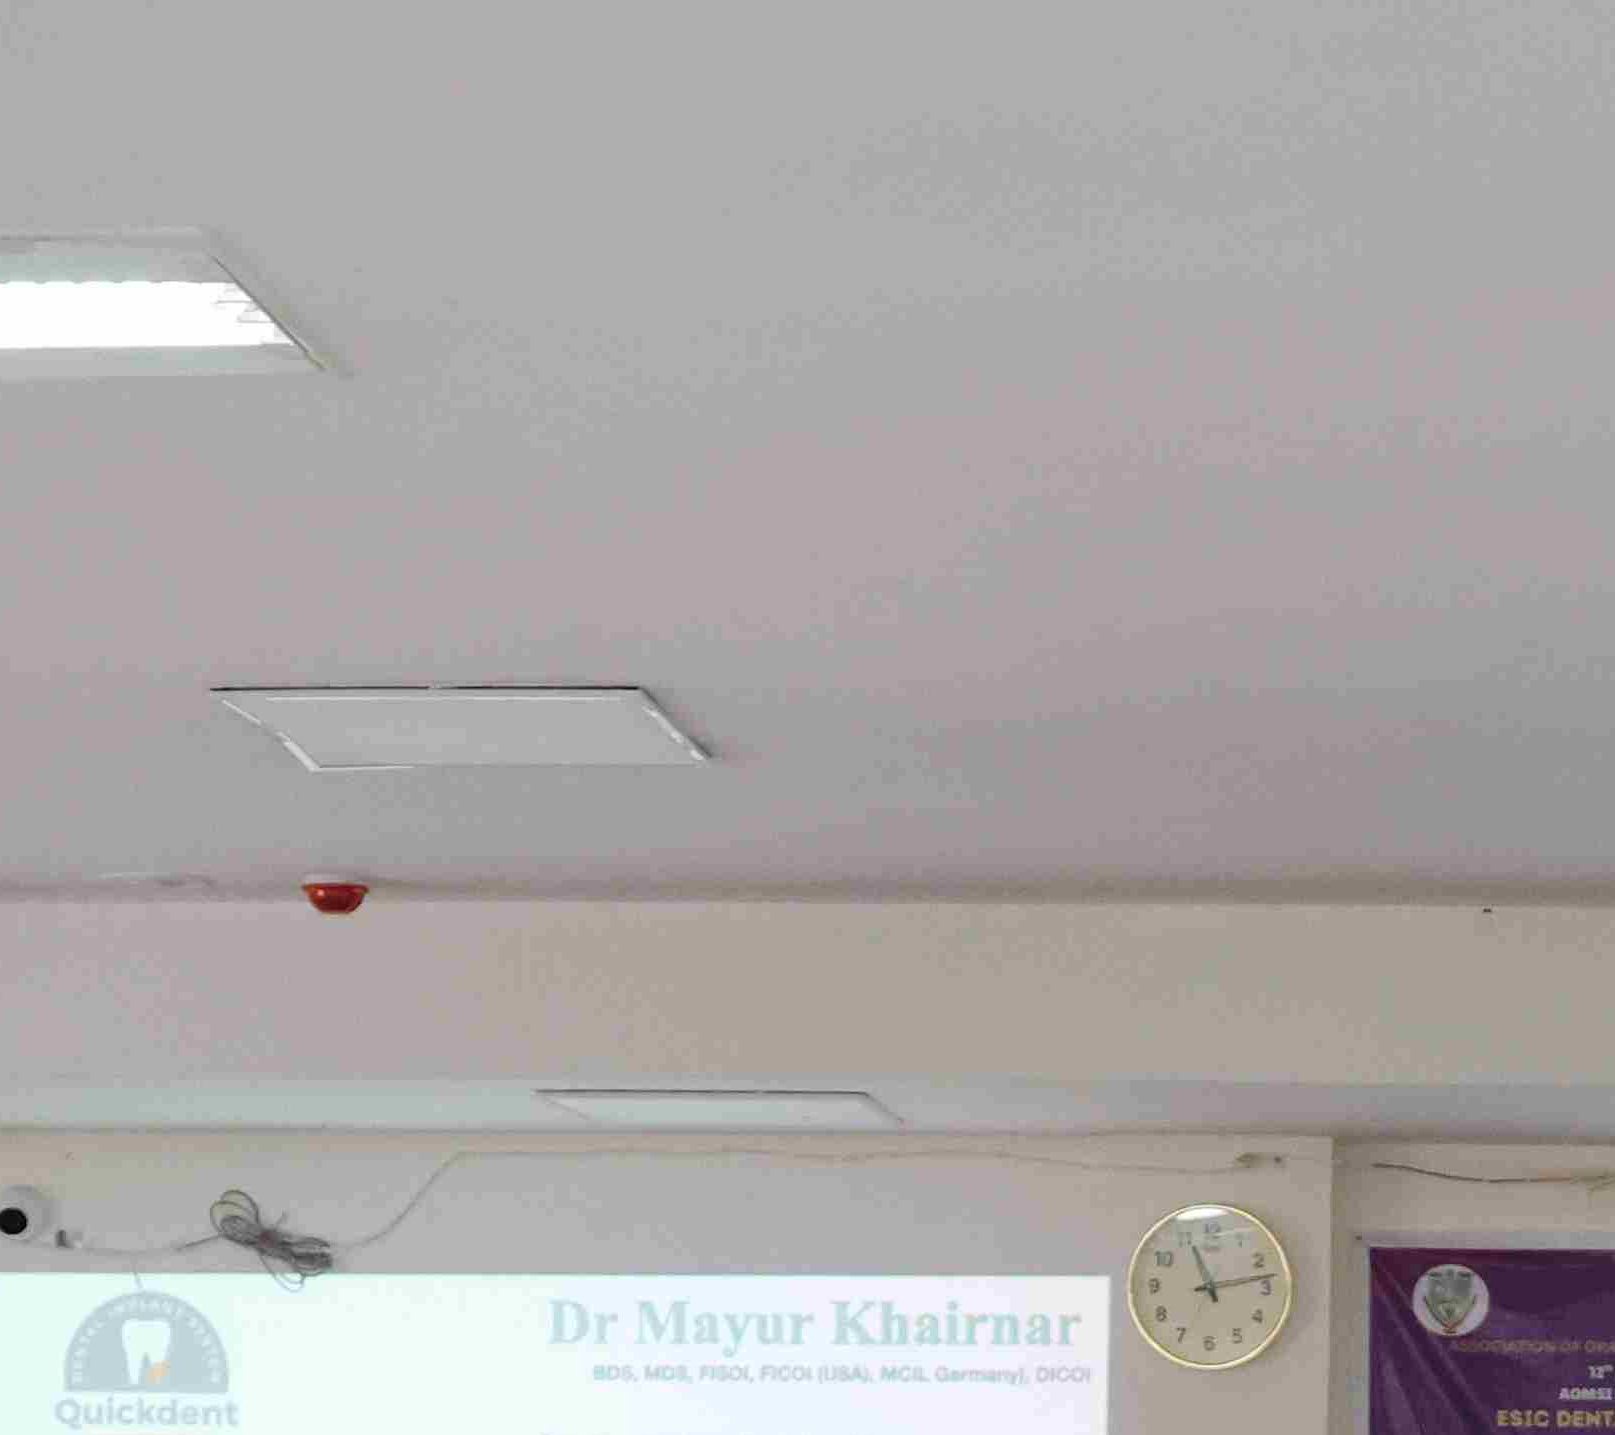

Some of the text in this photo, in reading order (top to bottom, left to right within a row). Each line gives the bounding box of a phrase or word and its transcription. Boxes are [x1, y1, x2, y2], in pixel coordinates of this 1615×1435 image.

[1155, 1251, 1173, 1267] 10
[1253, 1254, 1265, 1268] 2
[1148, 1279, 1160, 1293] 9
[1261, 1280, 1272, 1295] 3
[1155, 1306, 1167, 1322] 8
[1252, 1309, 1263, 1323] 4
[547, 1297, 1082, 1358] Dr Mayur Khairnar
[1176, 1328, 1186, 1343] 7
[1232, 1329, 1243, 1343] 5
[1204, 1336, 1216, 1351] 6
[53, 1397, 240, 1429] Quickdent
[1497, 1409, 1550, 1428] ESIC
